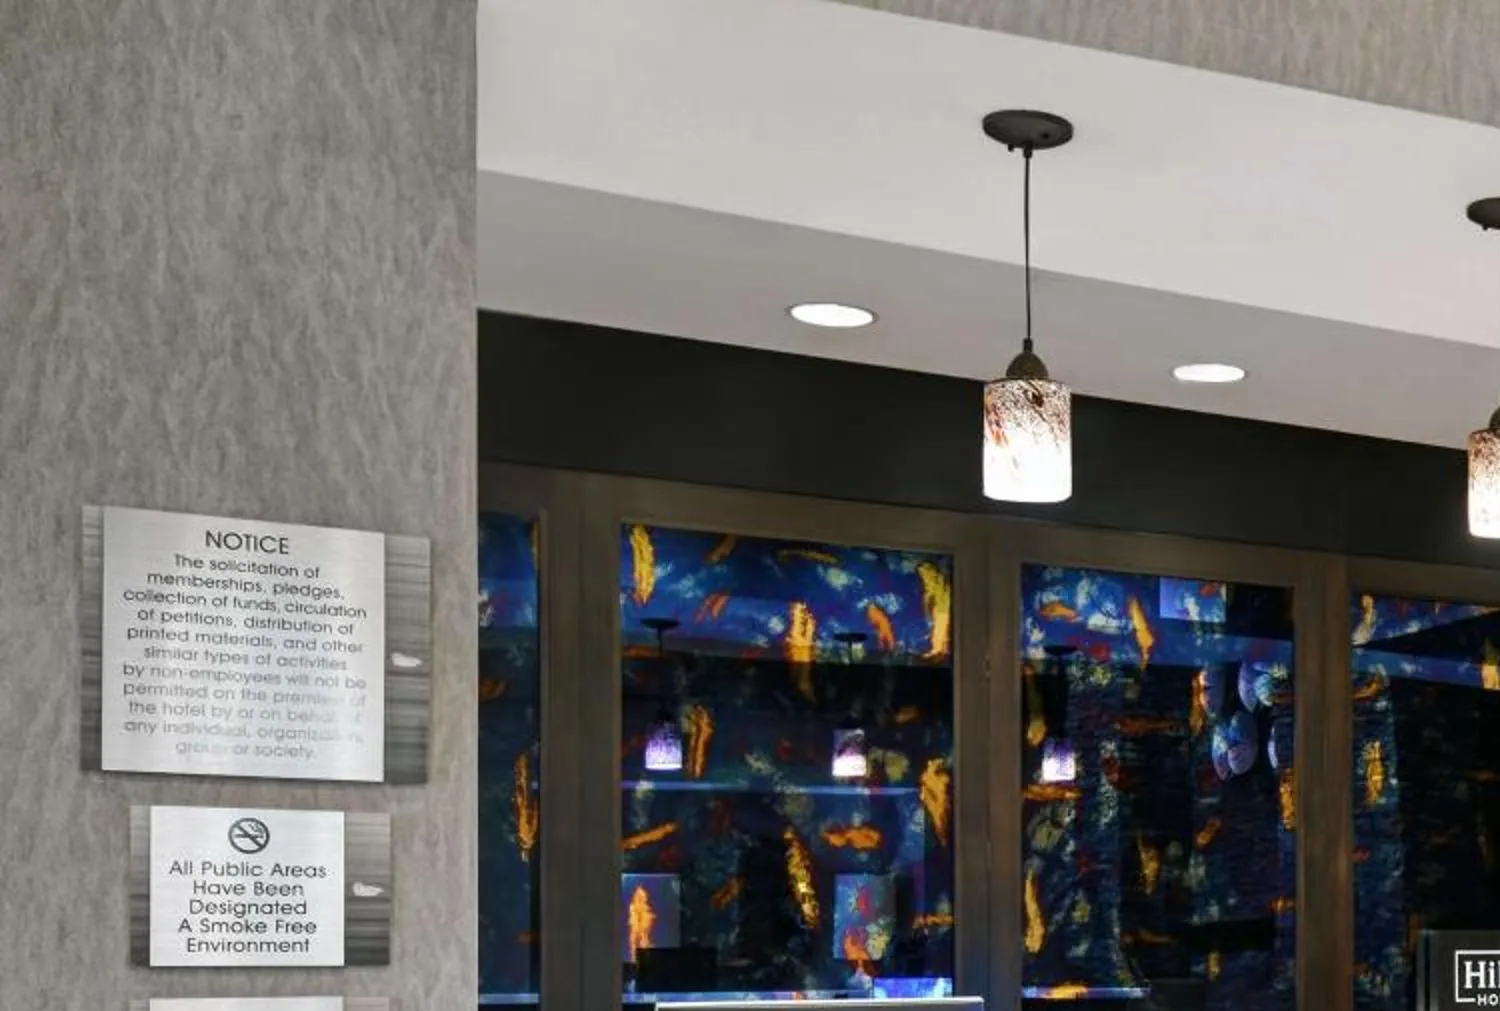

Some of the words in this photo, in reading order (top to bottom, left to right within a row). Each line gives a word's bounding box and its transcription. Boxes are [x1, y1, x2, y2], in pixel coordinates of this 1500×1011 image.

[205, 529, 289, 555] NOTICE
[174, 552, 205, 569] The
[209, 557, 299, 577] solicitation
[303, 565, 320, 579] of
[146, 572, 268, 595] memberships,
[273, 582, 345, 601] pledges,
[123, 588, 208, 606] collection
[211, 594, 229, 608] of
[233, 595, 281, 614] funds,
[284, 600, 367, 619] circulation
[137, 607, 156, 621] of
[160, 609, 238, 628] petitions,
[243, 615, 334, 634] distribution
[337, 622, 355, 635] of
[127, 625, 190, 642] printed
[195, 631, 278, 651] materials,
[283, 637, 318, 652] and
[321, 638, 364, 654] other
[143, 645, 200, 661] similar
[203, 648, 250, 665] types
[255, 652, 272, 666] of
[276, 654, 348, 672] activities
[123, 662, 146, 678] by
[150, 665, 283, 686] non-employees
[315, 675, 340, 689] not
[345, 677, 367, 690] be
[123, 682, 209, 699] permitted
[213, 688, 236, 700] on
[240, 687, 268, 701] the
[272, 691, 346, 707] premi
[129, 700, 159, 716] the
[162, 702, 207, 718] hotel
[211, 704, 233, 721] by
[236, 709, 255, 721] or
[260, 709, 282, 721] on
[123, 720, 158, 737] any
[169, 860, 194, 876] All
[201, 861, 264, 877] Public
[270, 862, 328, 879] Areas
[193, 880, 246, 896] Have
[254, 881, 306, 897] Been
[189, 899, 308, 919] Designated
[177, 918, 193, 934] A
[199, 917, 268, 935] Smoke
[275, 919, 318, 936] Free
[187, 937, 310, 954] Environment
